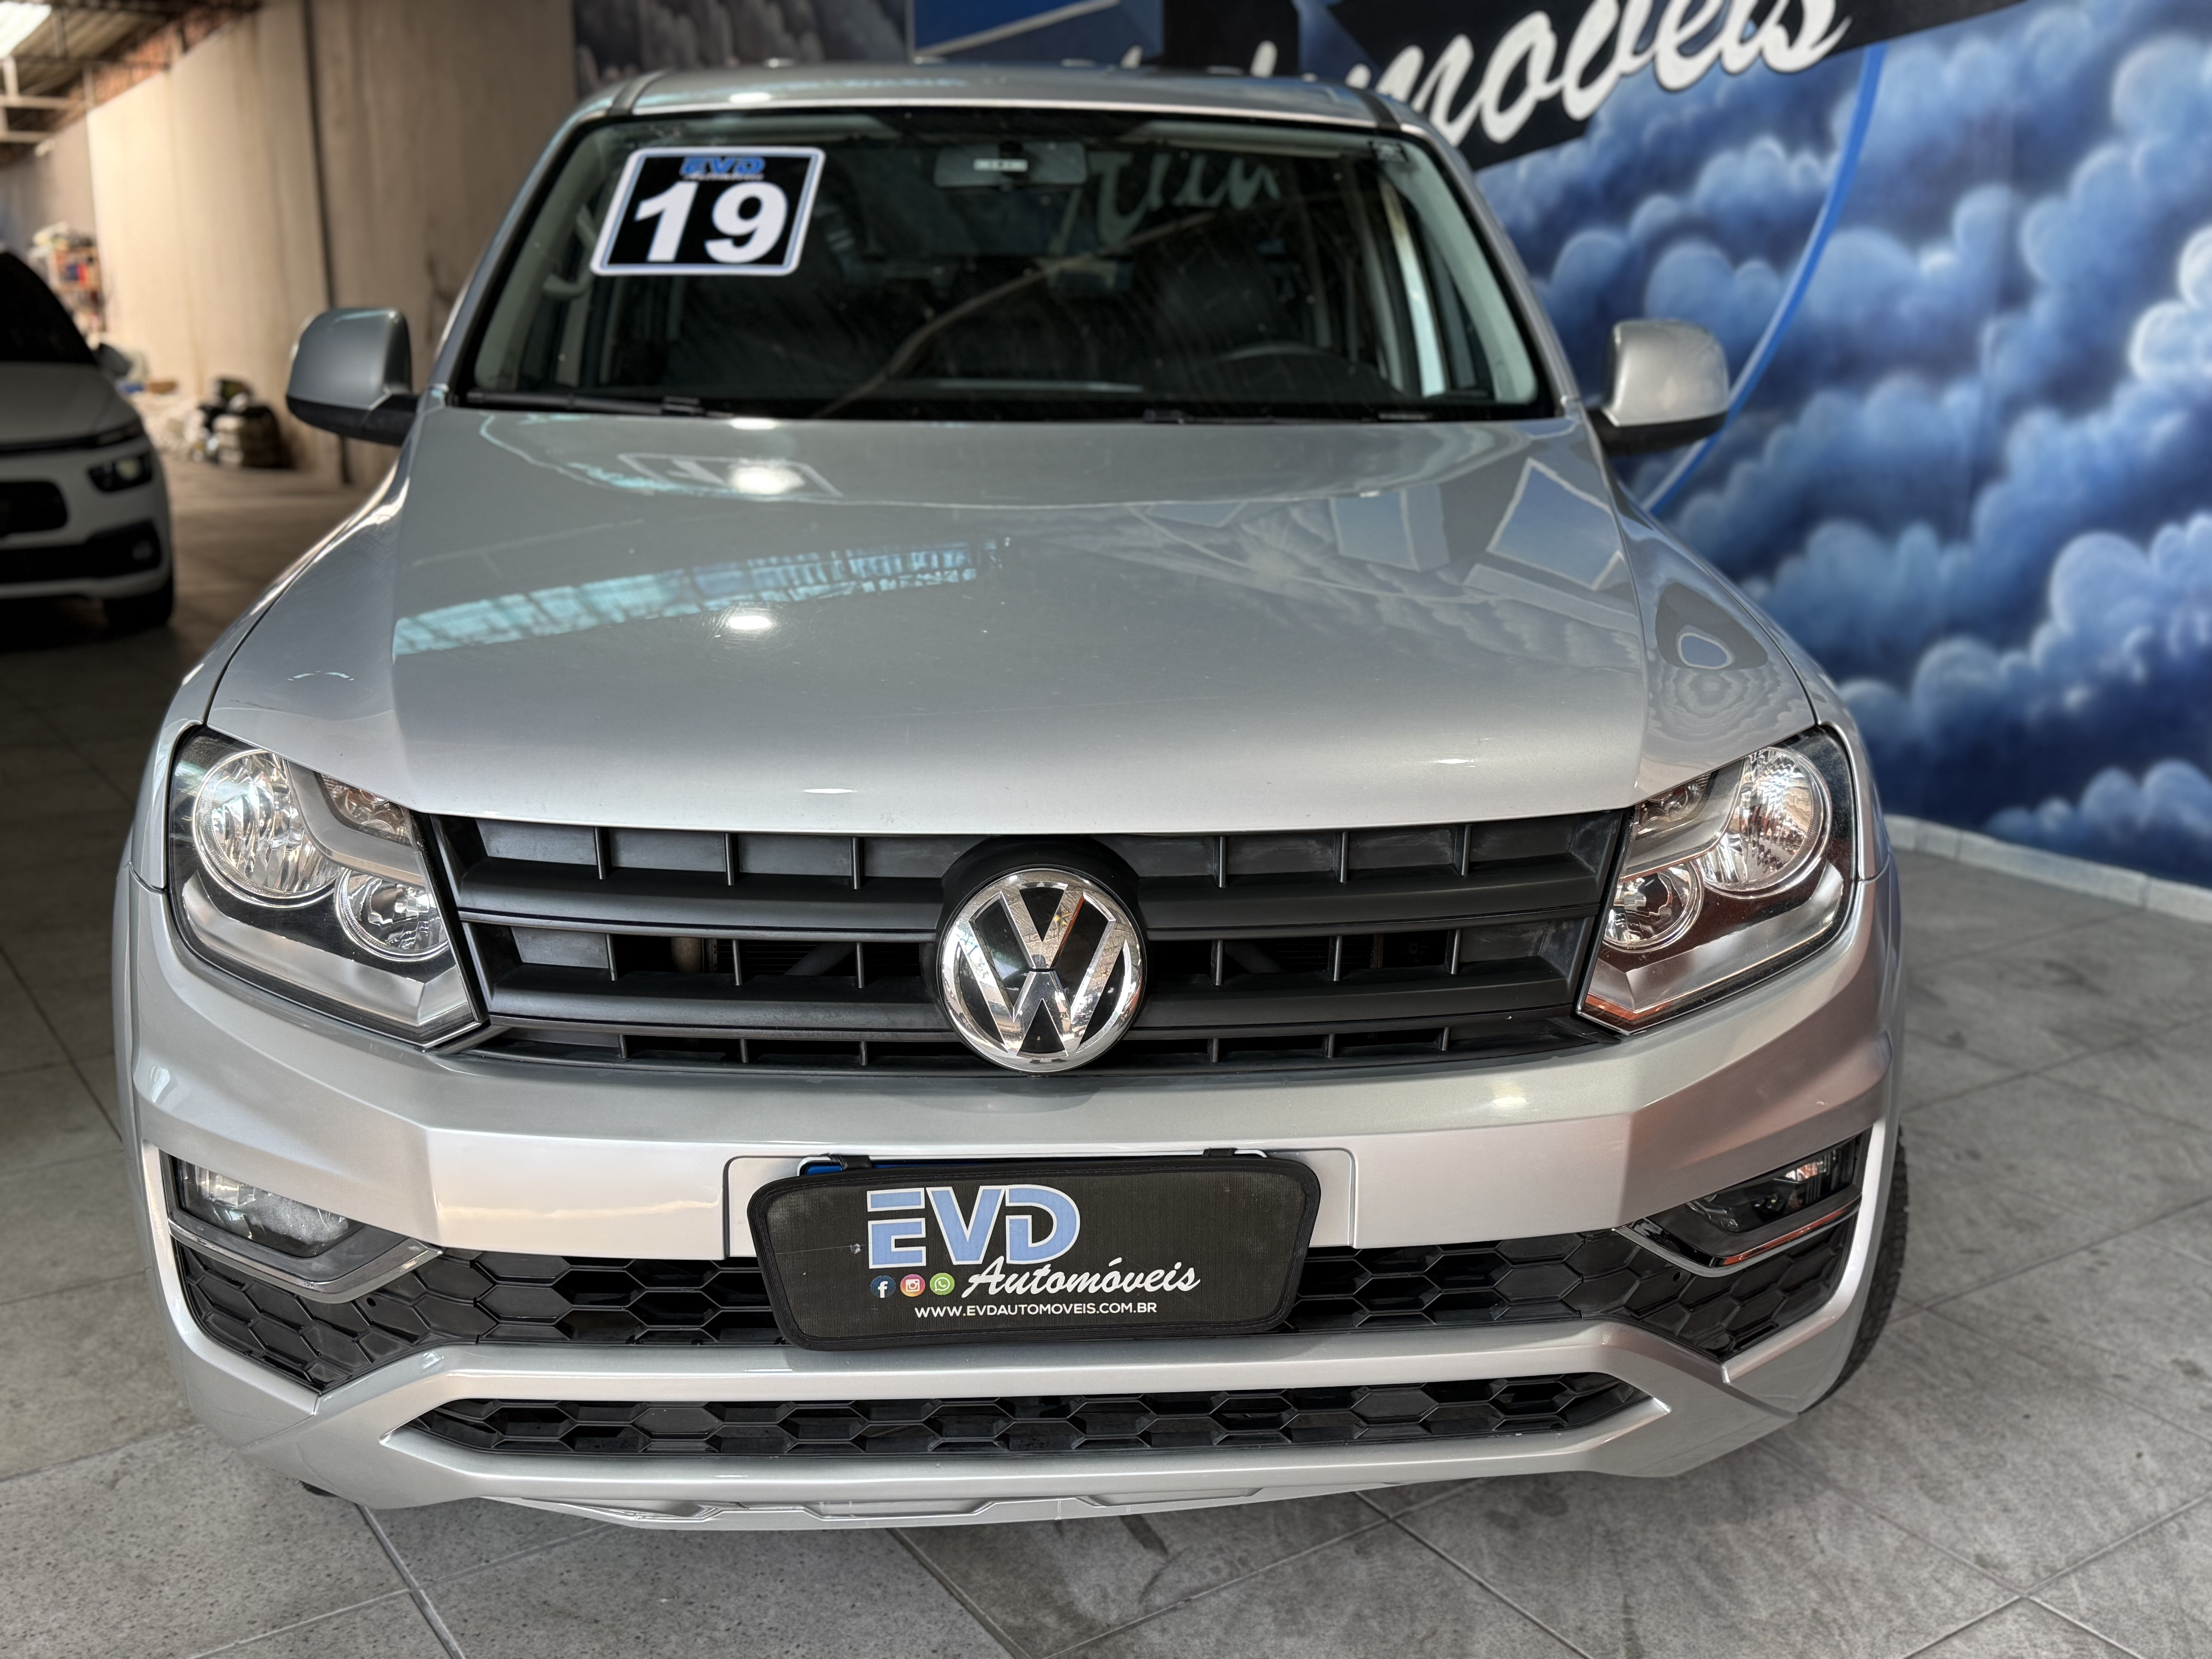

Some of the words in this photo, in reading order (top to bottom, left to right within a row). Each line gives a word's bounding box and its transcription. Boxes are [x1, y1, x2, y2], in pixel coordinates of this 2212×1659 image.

[679, 156, 766, 175] EVD
[634, 181, 789, 263] 19
[867, 1184, 1080, 1269] EVD
[961, 1255, 1200, 1298] Automóveis
[914, 1302, 1157, 1318] WWW.EVDAUTOMOVEIS.COM.BR
